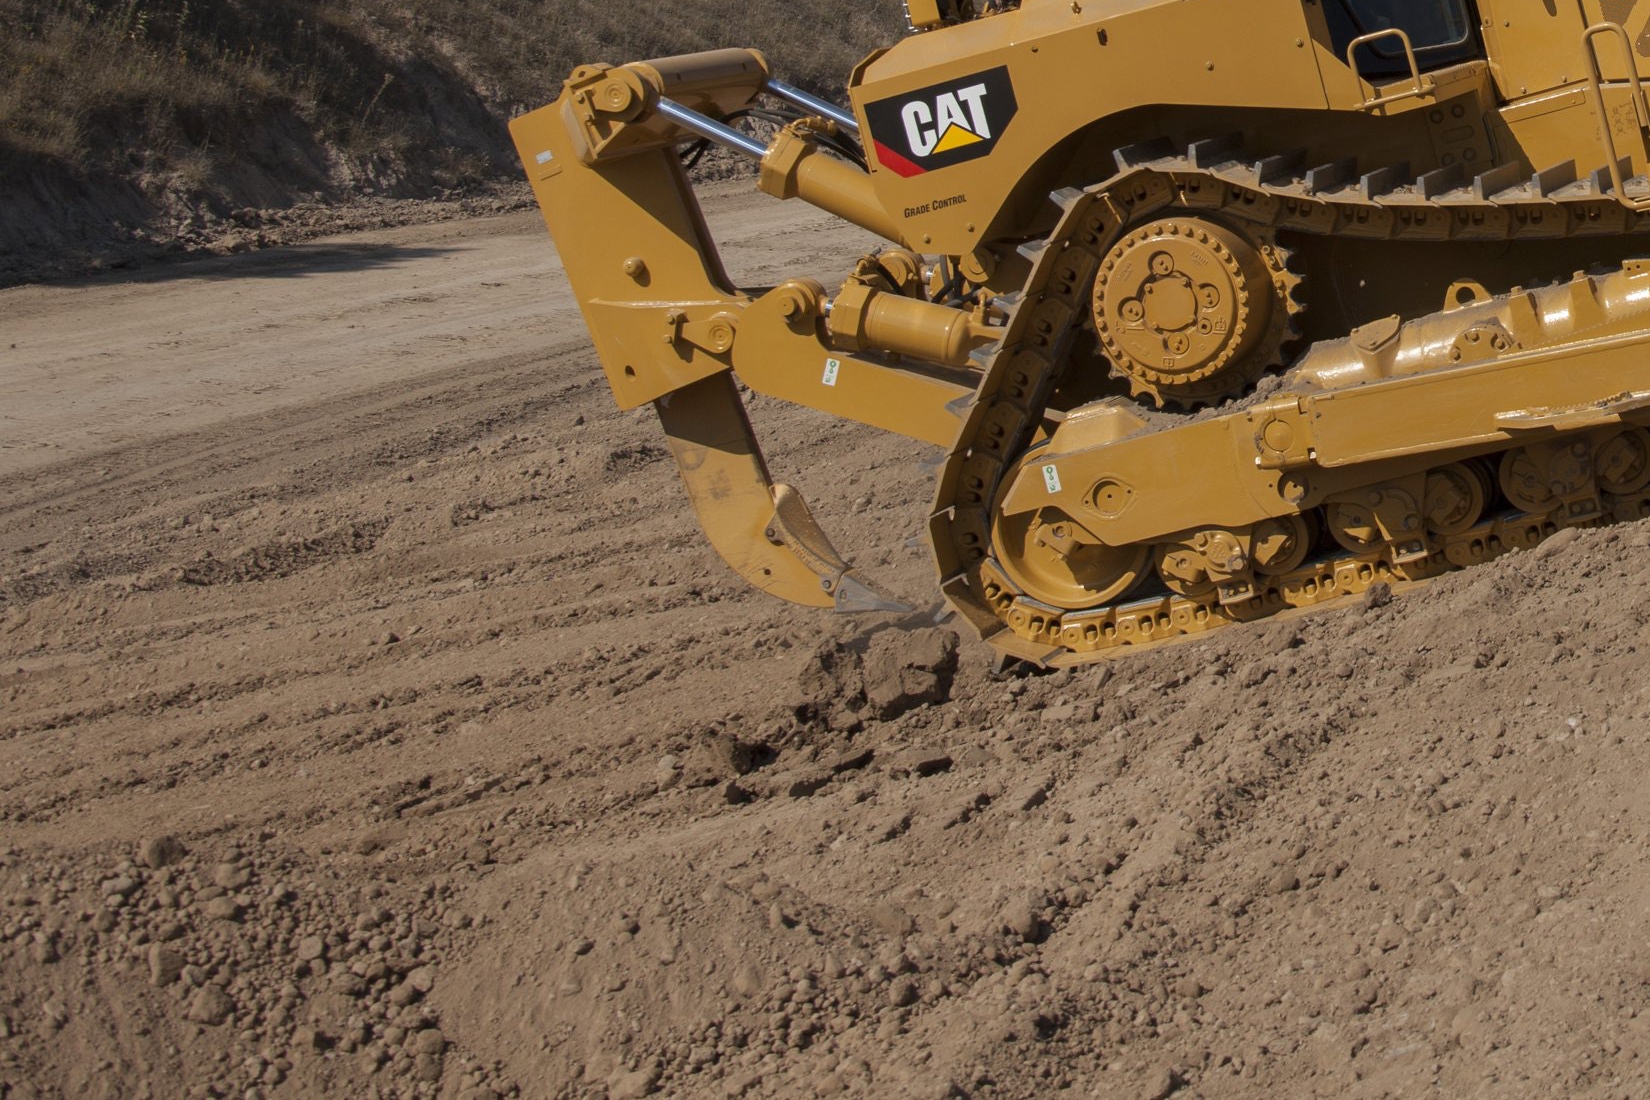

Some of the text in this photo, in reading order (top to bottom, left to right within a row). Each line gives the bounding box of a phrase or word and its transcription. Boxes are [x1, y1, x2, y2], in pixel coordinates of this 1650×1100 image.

[901, 82, 991, 157] CAT
[904, 194, 967, 218] GRADE CONTROL
